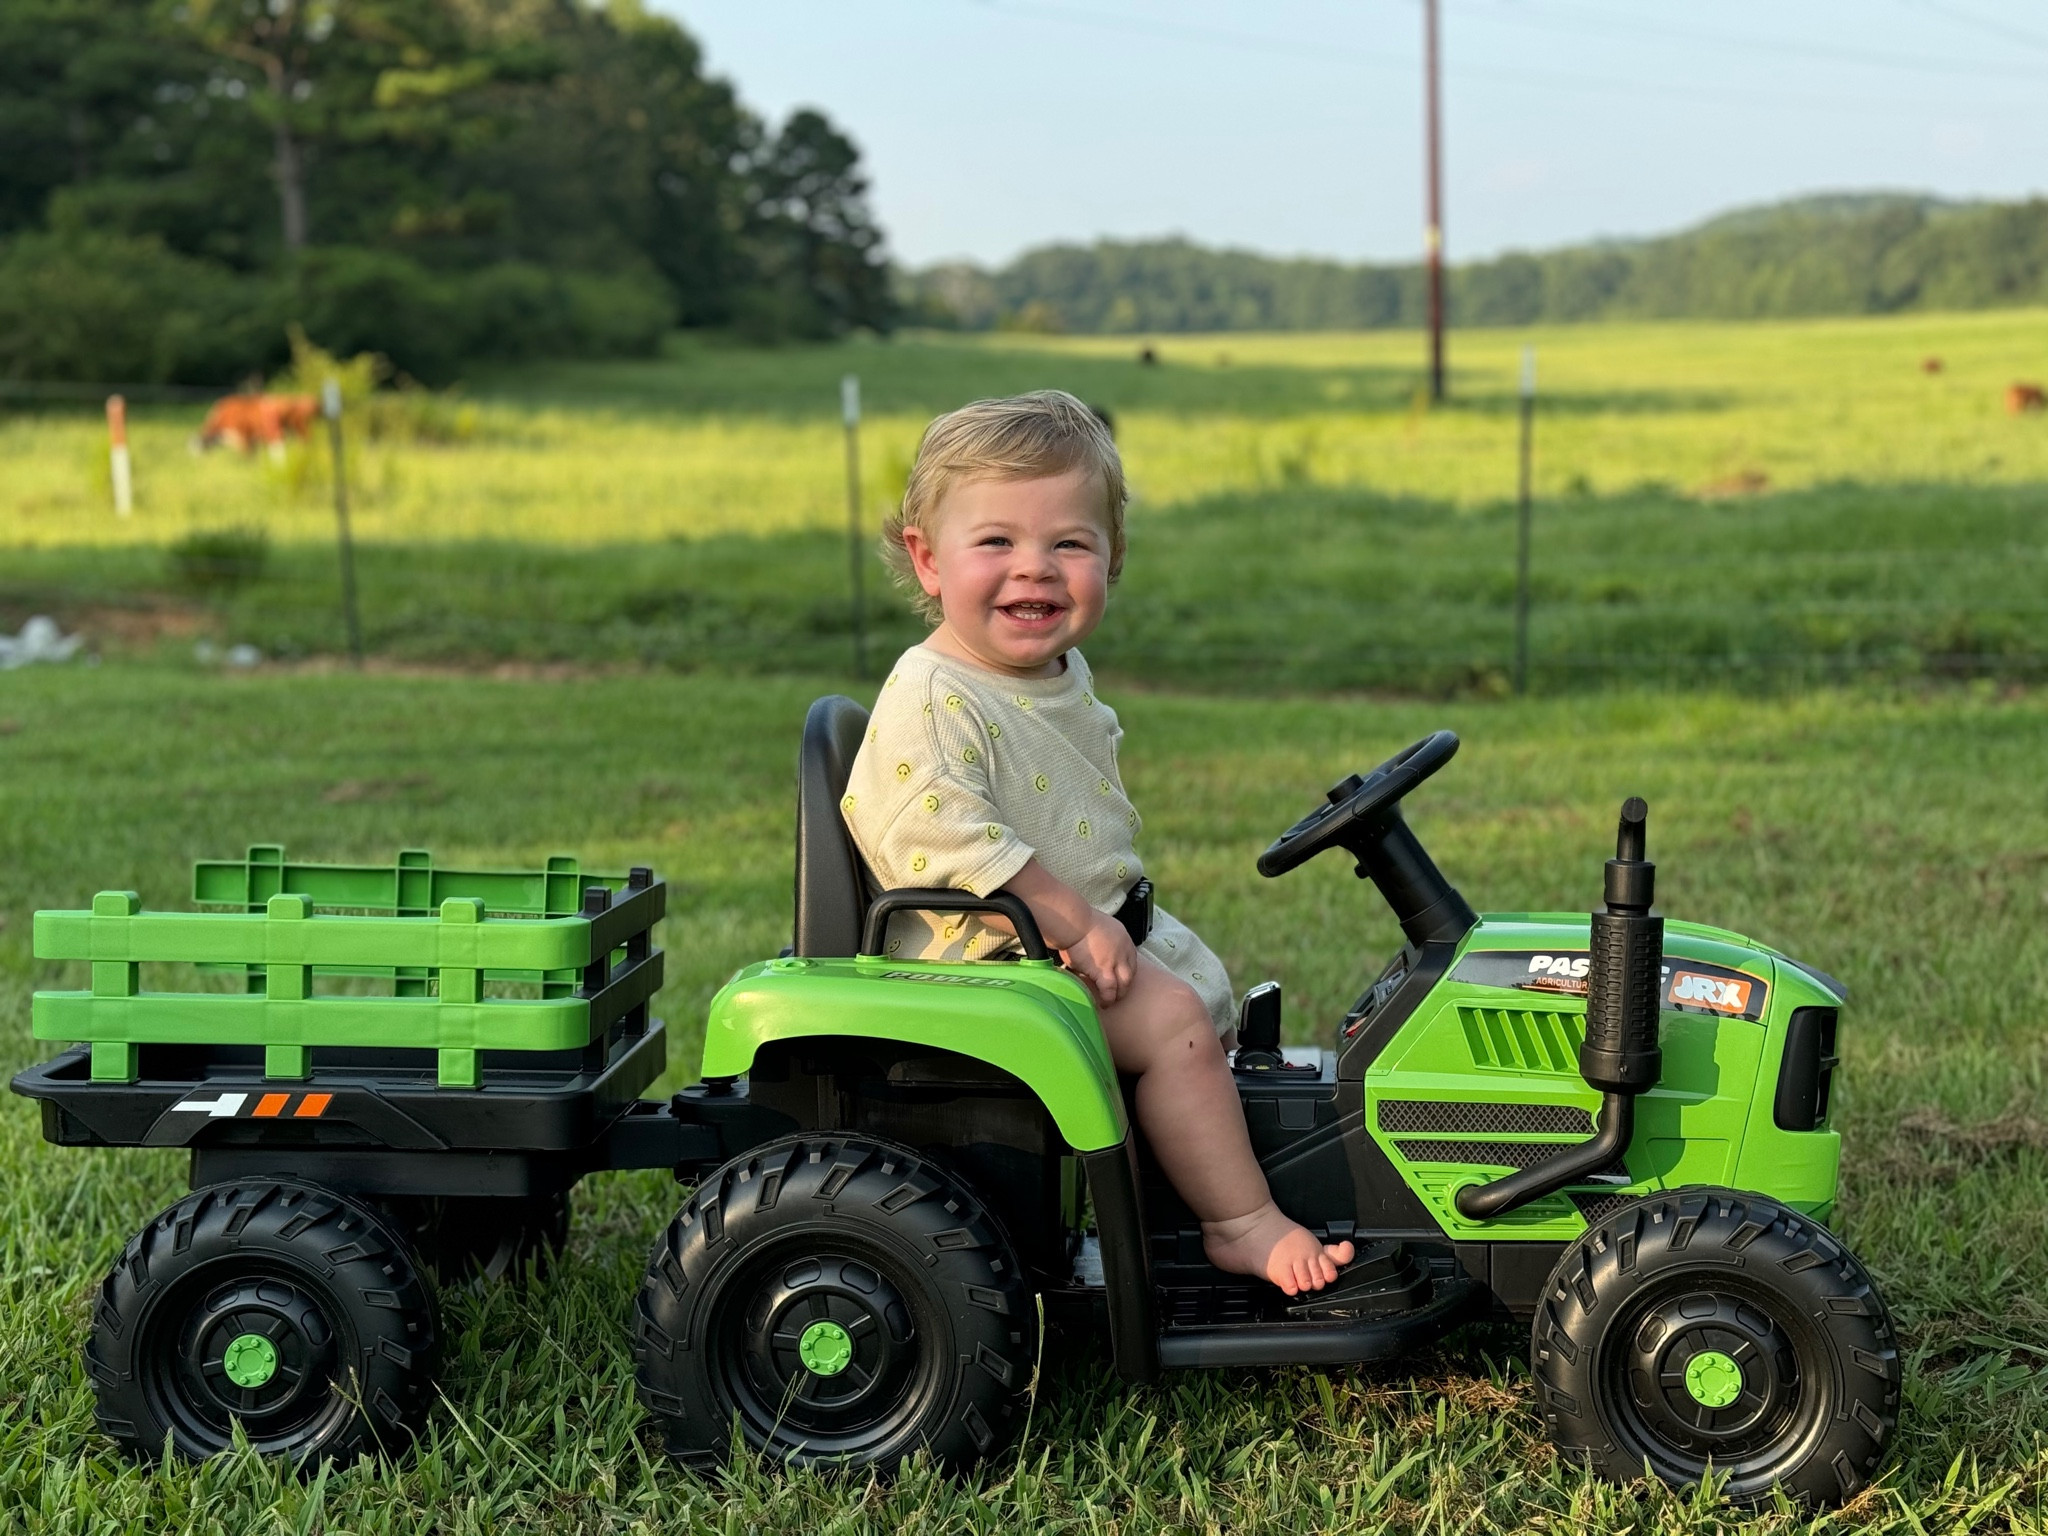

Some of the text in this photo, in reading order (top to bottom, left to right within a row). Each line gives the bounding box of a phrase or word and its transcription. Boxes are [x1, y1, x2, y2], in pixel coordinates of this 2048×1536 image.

[1528, 955, 1591, 978] PAS
[885, 971, 1012, 986] POWER
[1535, 976, 1589, 990] AGRICULTUR
[1673, 975, 1743, 1008] JRX
